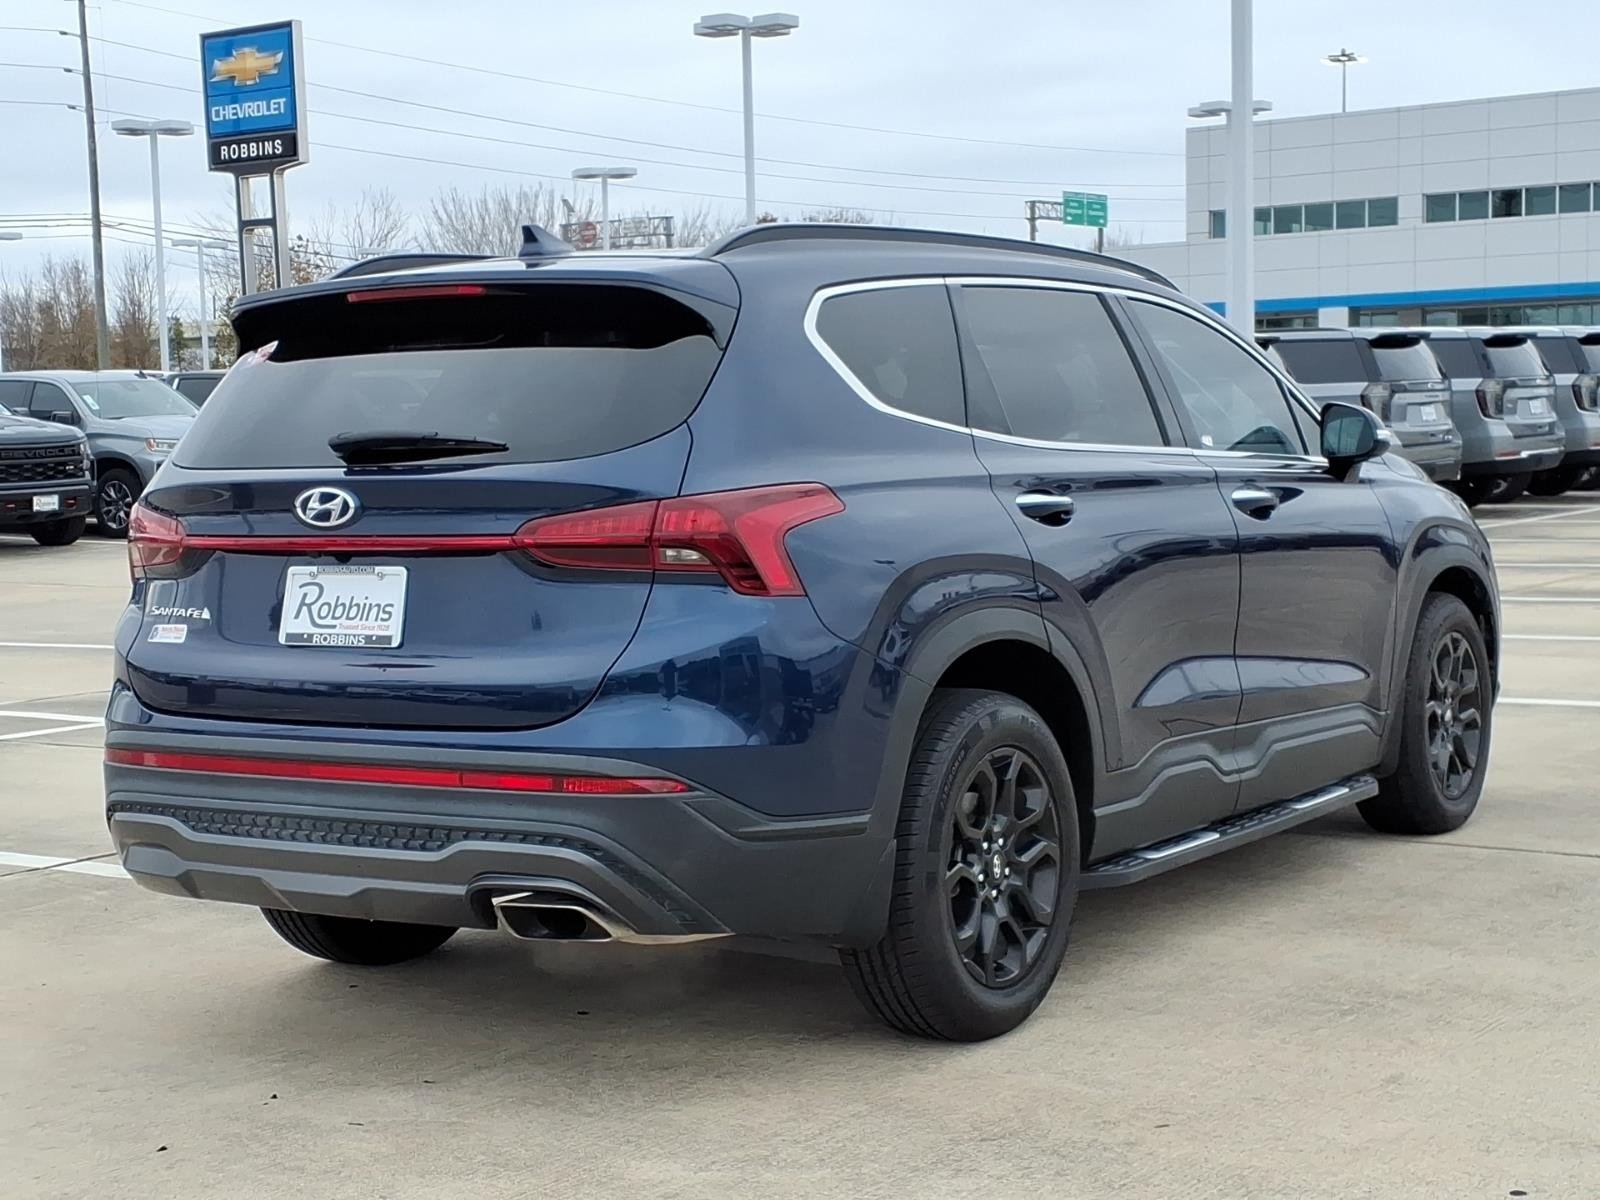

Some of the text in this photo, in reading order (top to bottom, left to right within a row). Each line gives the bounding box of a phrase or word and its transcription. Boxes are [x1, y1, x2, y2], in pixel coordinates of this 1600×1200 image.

[211, 98, 286, 122] CHEVROLET
[220, 139, 283, 160] ROBBINS
[0, 448, 79, 459] HEVROLET
[149, 605, 186, 617] SANTA
[293, 581, 395, 630] Robbins
[312, 633, 366, 645] ROBBINS
